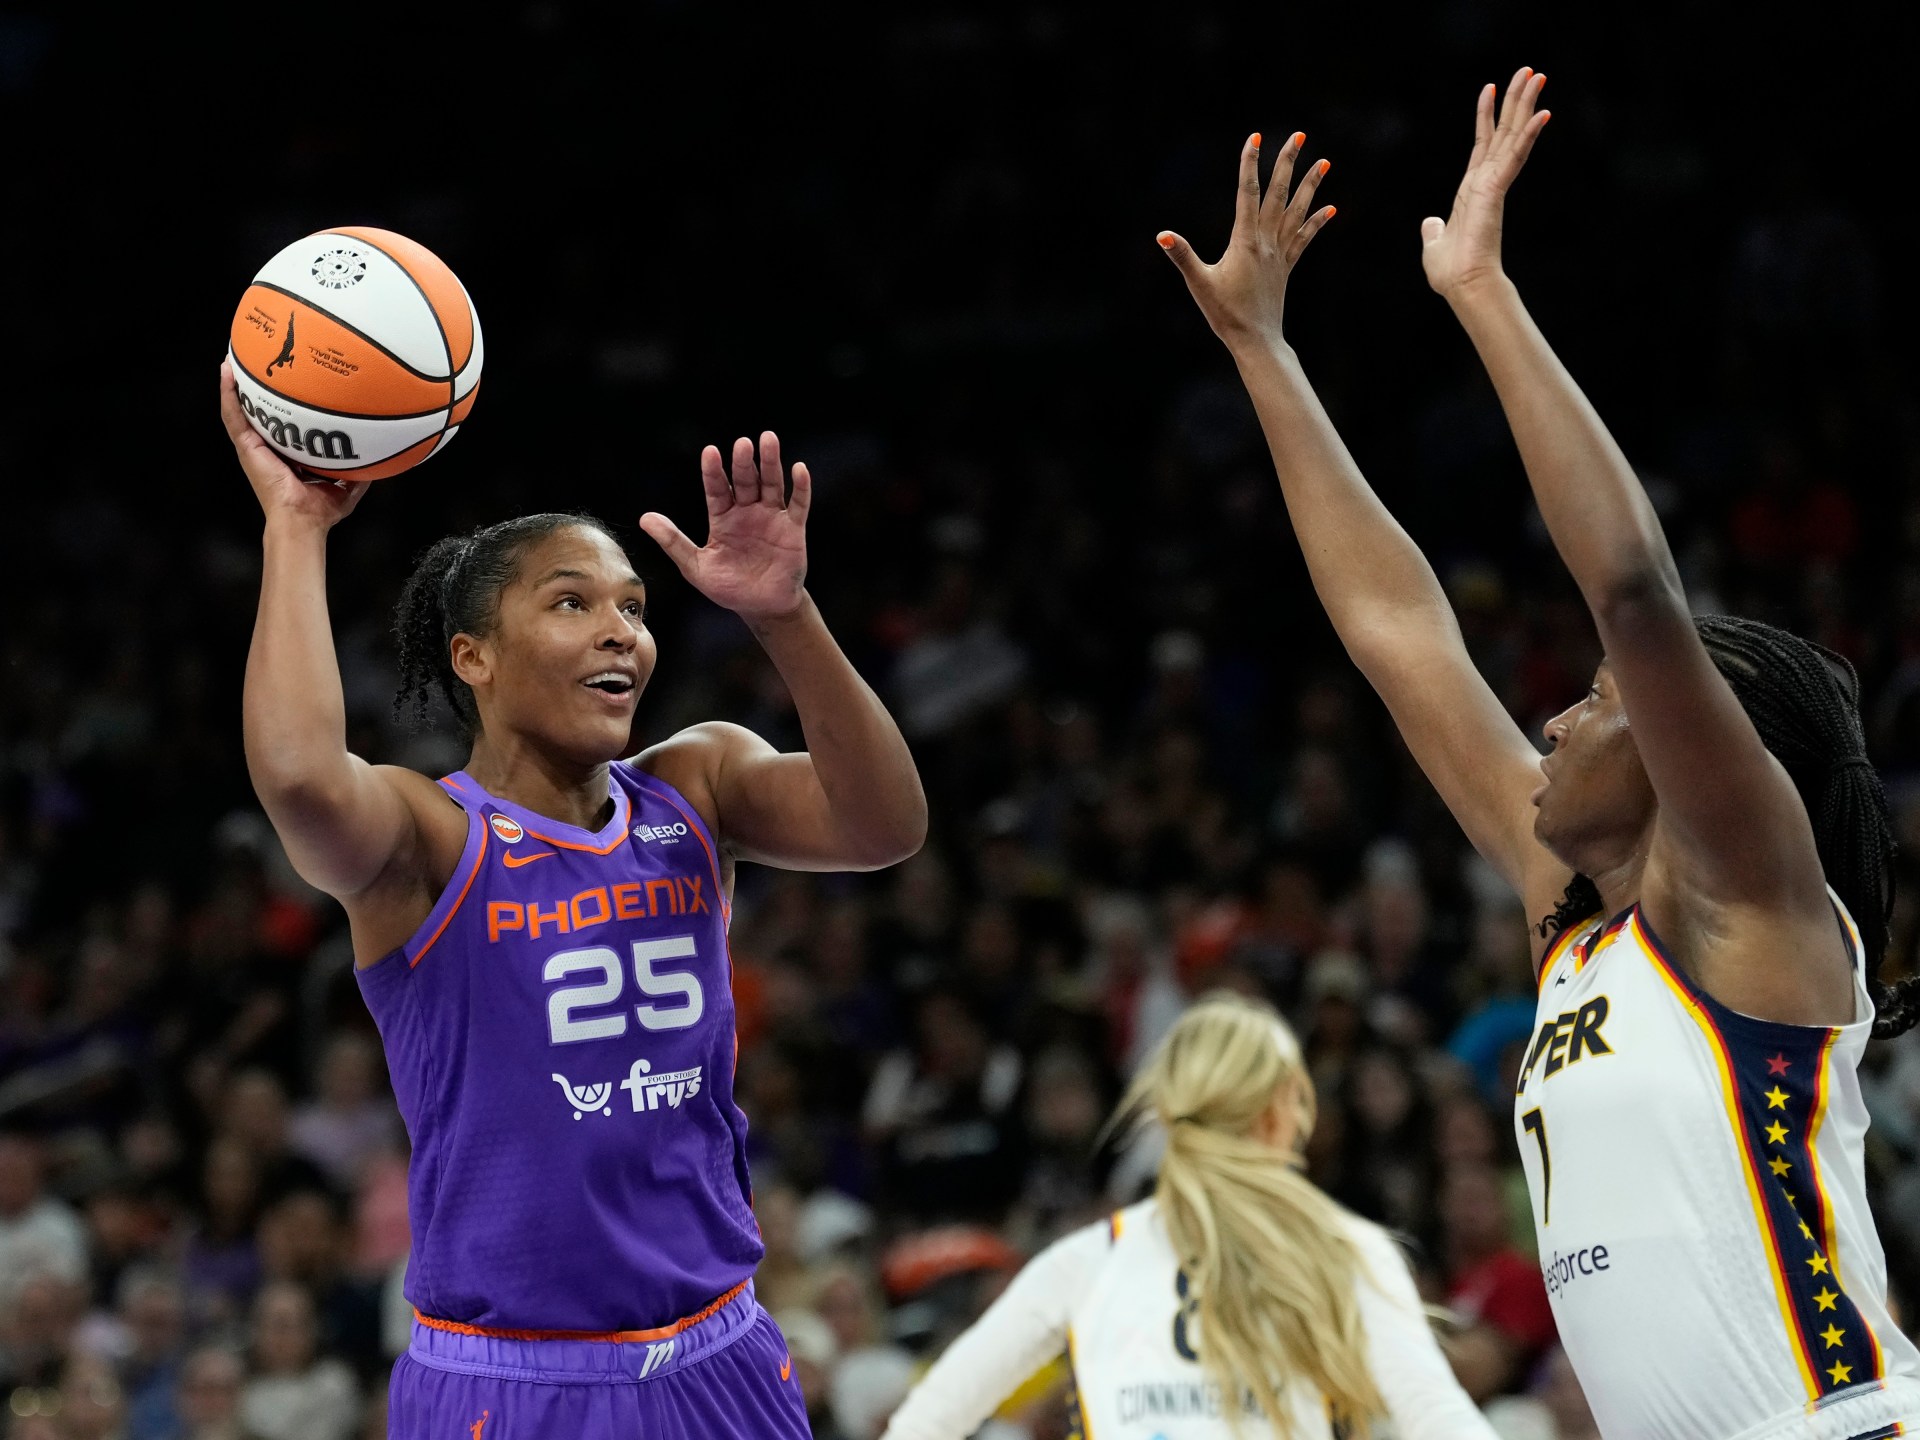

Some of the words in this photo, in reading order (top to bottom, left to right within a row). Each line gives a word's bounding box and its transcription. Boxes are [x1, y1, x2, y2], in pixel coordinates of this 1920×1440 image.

[308, 346, 331, 360] BALL
[311, 356, 350, 377] OFFICIAL
[332, 356, 359, 372] GAME
[633, 822, 688, 843] HERO
[487, 875, 710, 943] PHOENIX
[542, 933, 704, 1046] 25
[647, 1074, 671, 1084] FOOD
[673, 1068, 697, 1080] STORES
